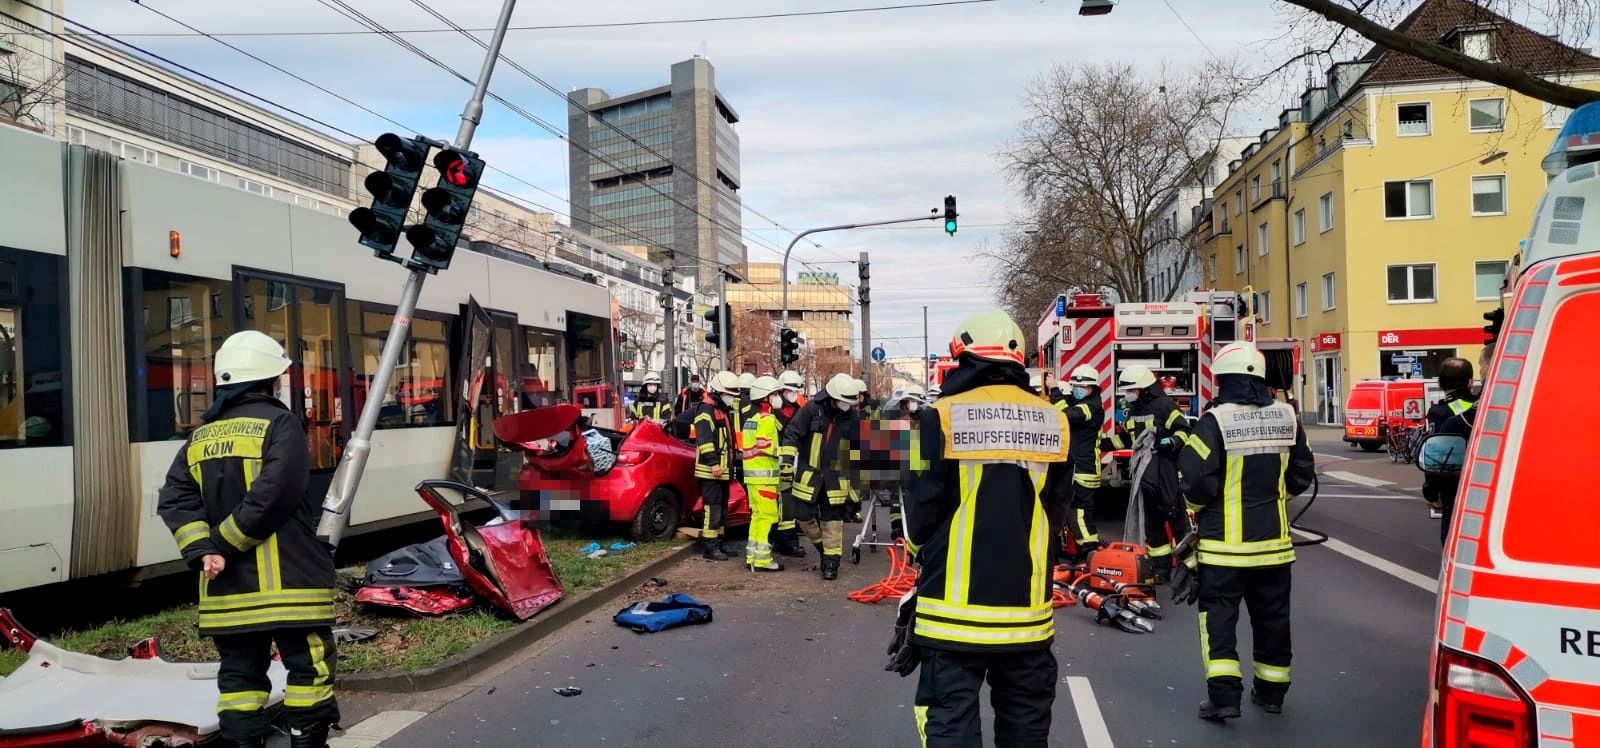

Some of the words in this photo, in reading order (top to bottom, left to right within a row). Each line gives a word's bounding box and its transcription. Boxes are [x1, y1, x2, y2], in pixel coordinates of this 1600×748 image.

[1381, 333, 1399, 343] DER
[967, 407, 1045, 423] EINSATZLEITER
[1233, 410, 1284, 421] EINSATZLEITER
[1226, 425, 1294, 438] BERUFSFEUERWEHR
[953, 430, 1060, 447] BERUFSFEUERWEHR
